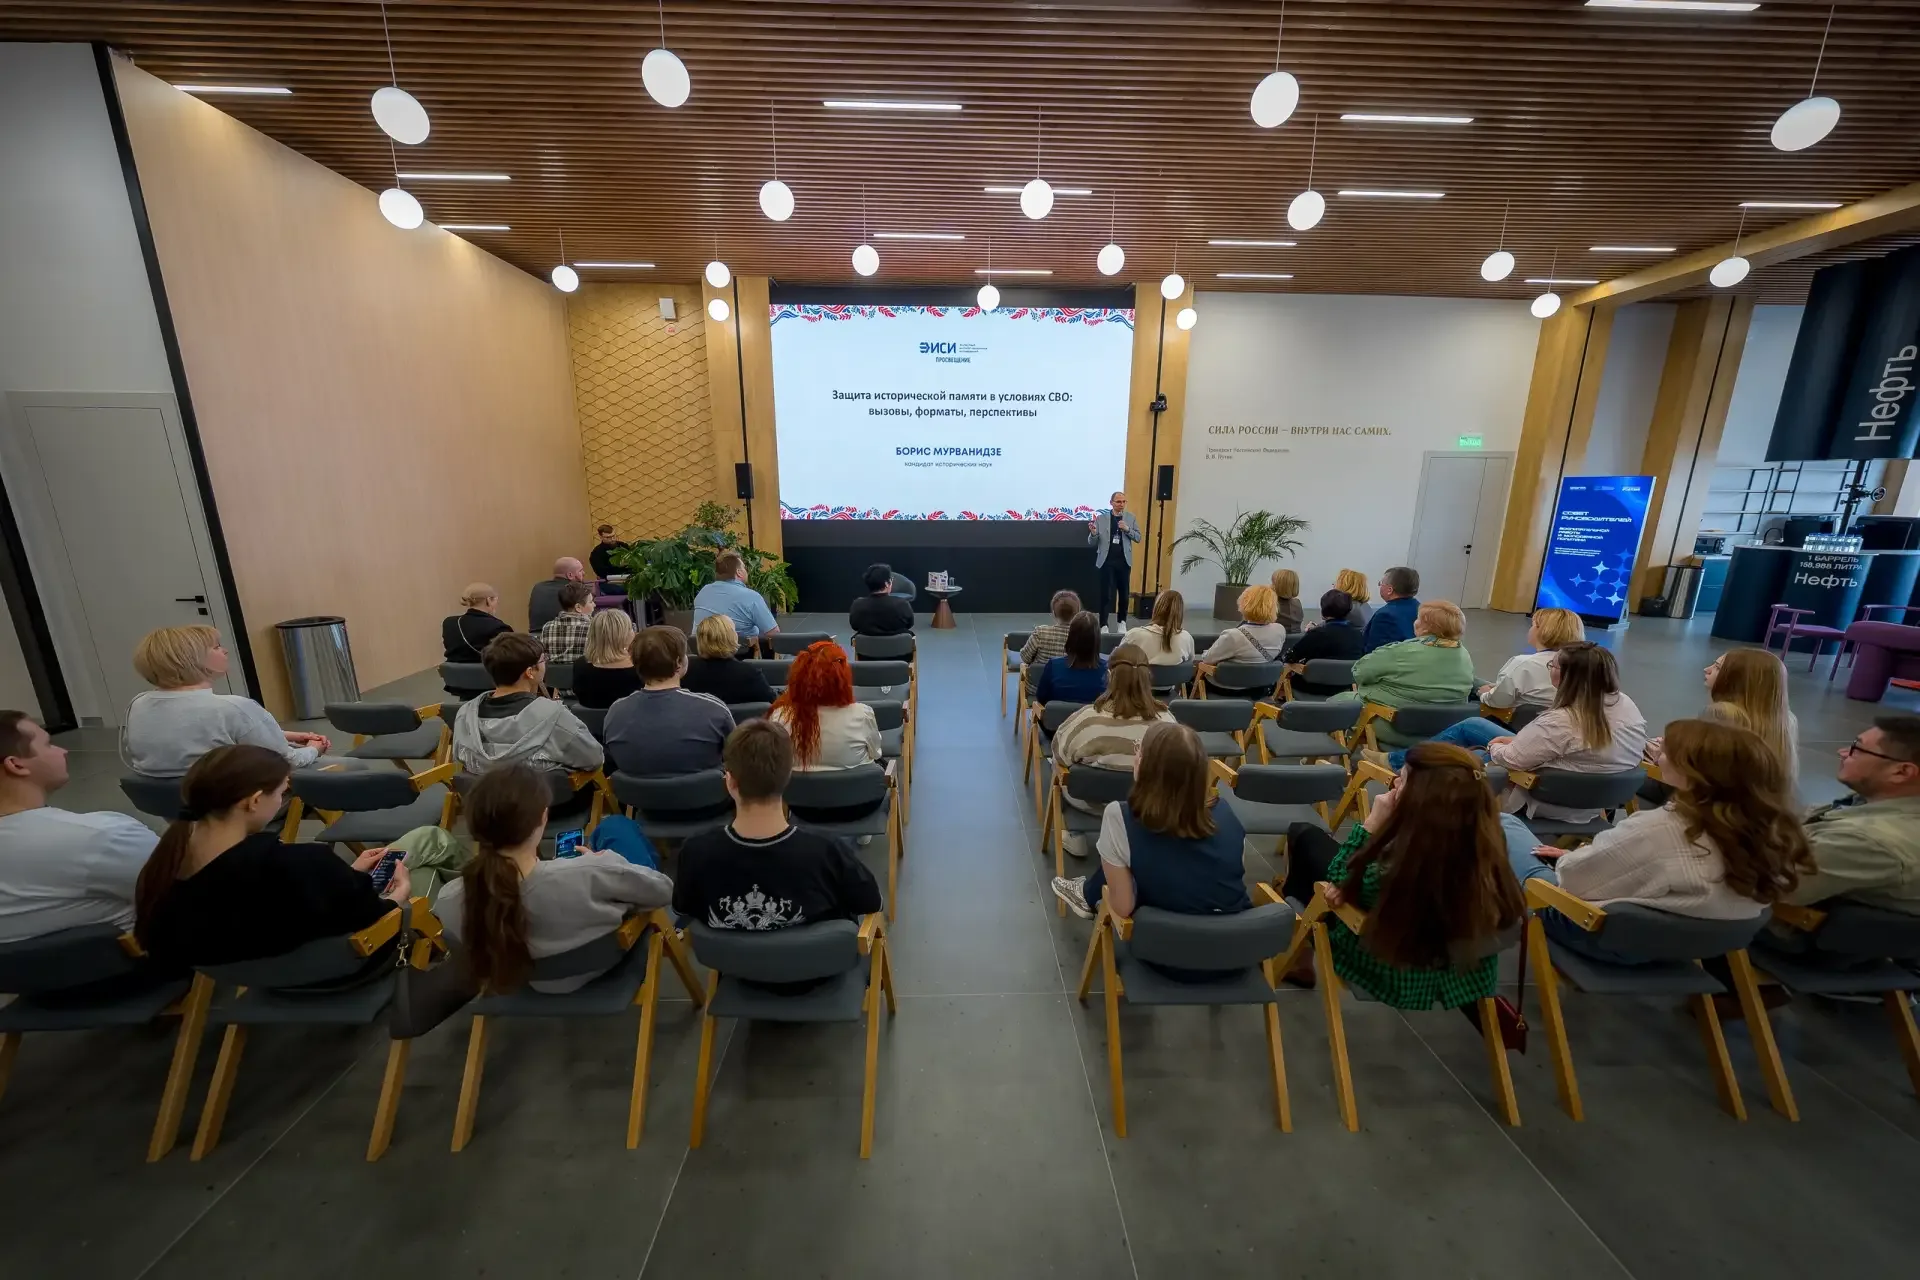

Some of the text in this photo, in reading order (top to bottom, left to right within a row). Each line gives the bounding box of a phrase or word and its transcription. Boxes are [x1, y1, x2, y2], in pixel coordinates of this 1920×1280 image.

[832, 390, 1073, 403] Защита исторической памяти в условиях СВО:
[1854, 345, 1918, 441] Нефть
[868, 406, 1037, 418] вызовы, форматы, перспективы
[1208, 425, 1235, 435] СИЛА
[1238, 425, 1279, 435] РОССИИ
[1290, 426, 1329, 435] ВНУТРИ
[1332, 426, 1352, 435] НАС
[1354, 426, 1392, 436] САМИХ.
[895, 447, 1002, 457] БОРИС МУРВАНИДЗЕ
[1814, 555, 1859, 563] БАРРЕЛЬ
[1794, 572, 1858, 588] Нефть
